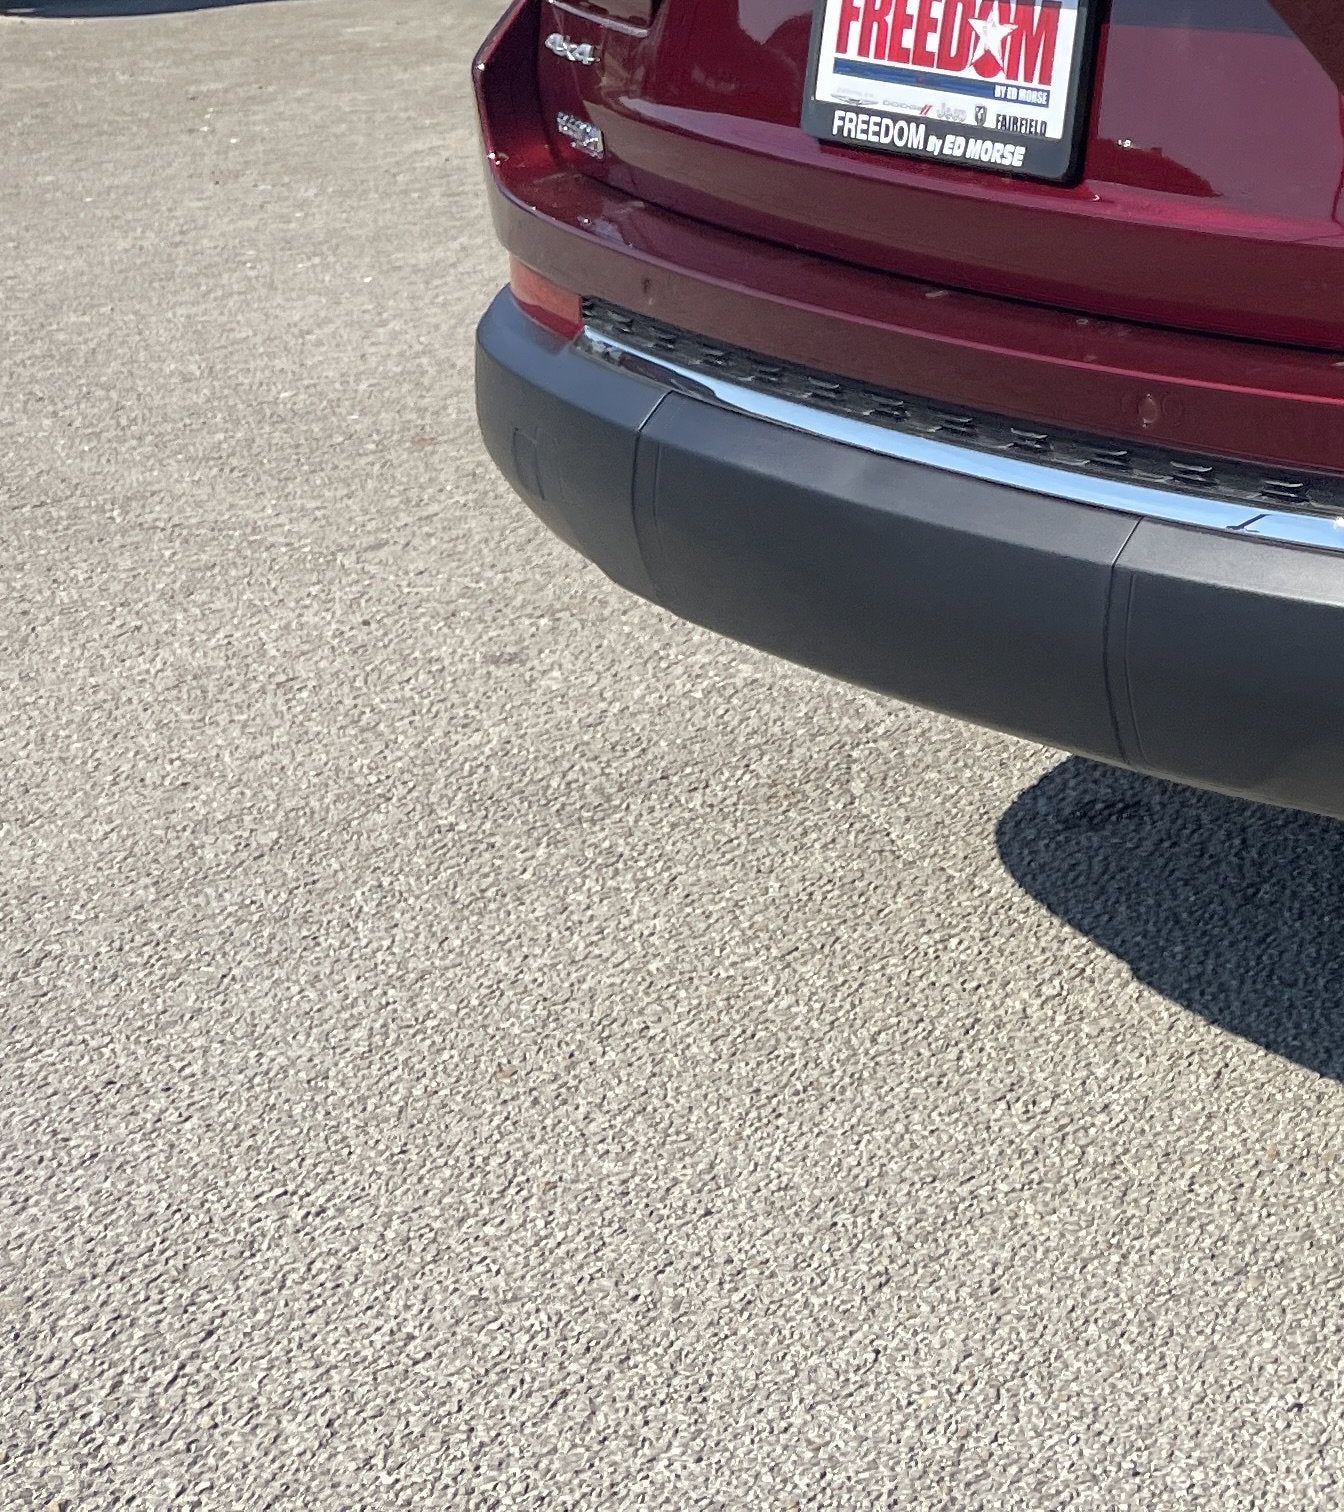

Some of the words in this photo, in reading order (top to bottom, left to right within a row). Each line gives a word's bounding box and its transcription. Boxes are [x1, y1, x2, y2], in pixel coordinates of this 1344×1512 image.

[832, 109, 926, 150] FREEDOM
[942, 134, 966, 157] ED
[965, 138, 1026, 167] MORSE
[996, 113, 1048, 137] FAIRFIELD
